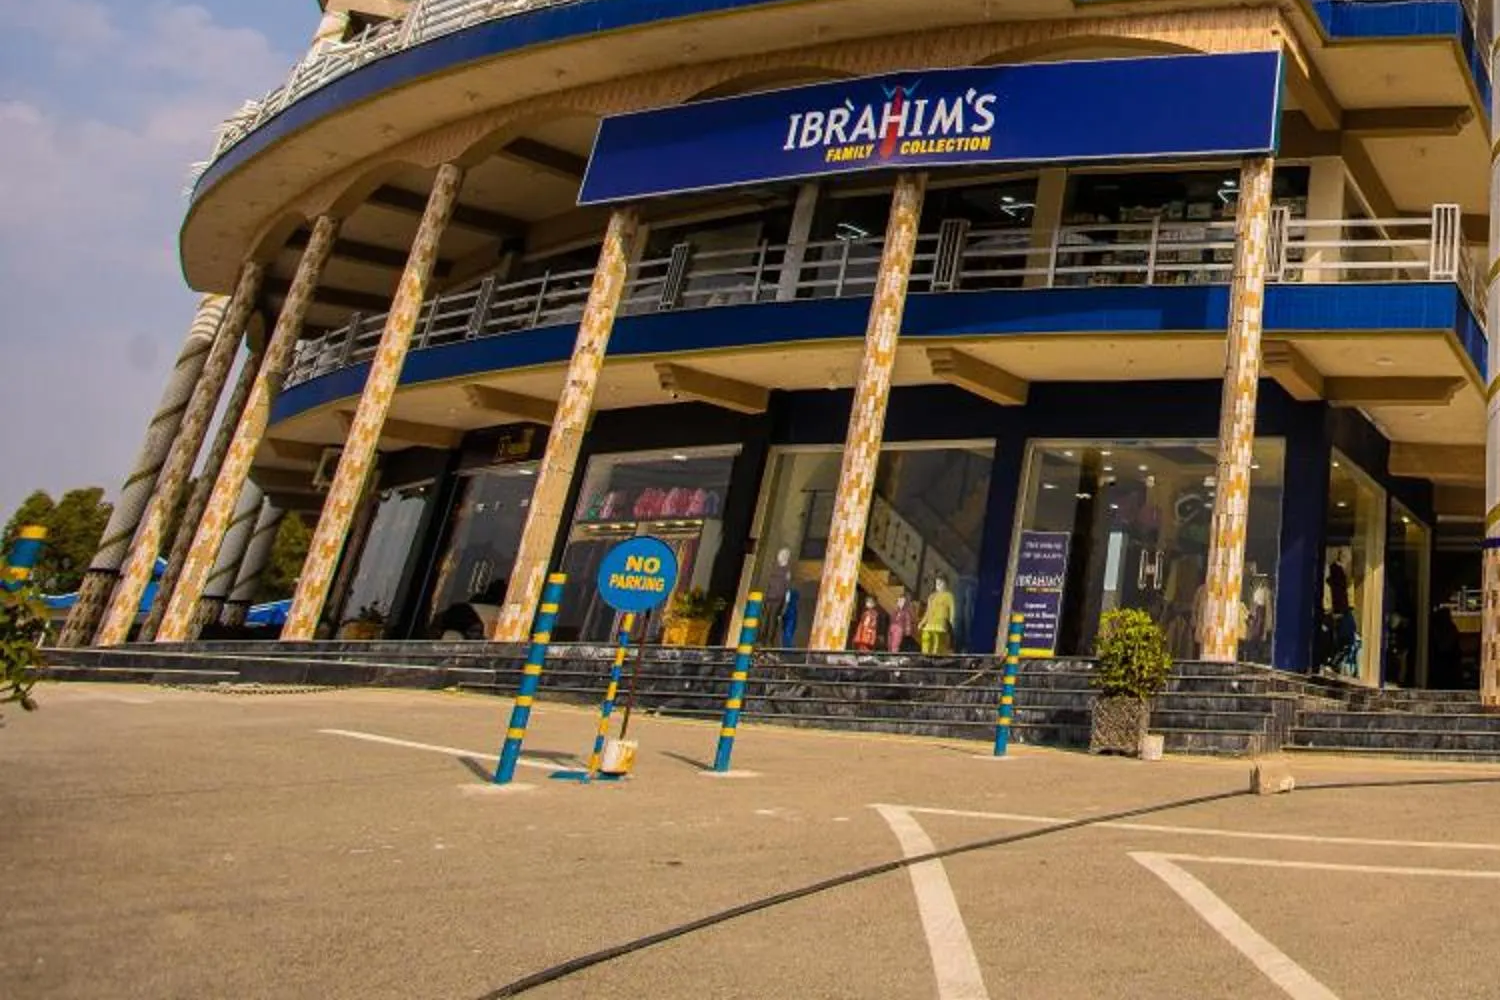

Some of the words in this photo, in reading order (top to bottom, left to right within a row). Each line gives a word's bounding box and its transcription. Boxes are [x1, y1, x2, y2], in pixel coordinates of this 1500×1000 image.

[825, 144, 875, 162] FAMILY
[901, 136, 992, 156] COLLECTION
[625, 555, 661, 575] NO
[608, 573, 665, 593] PARKING
